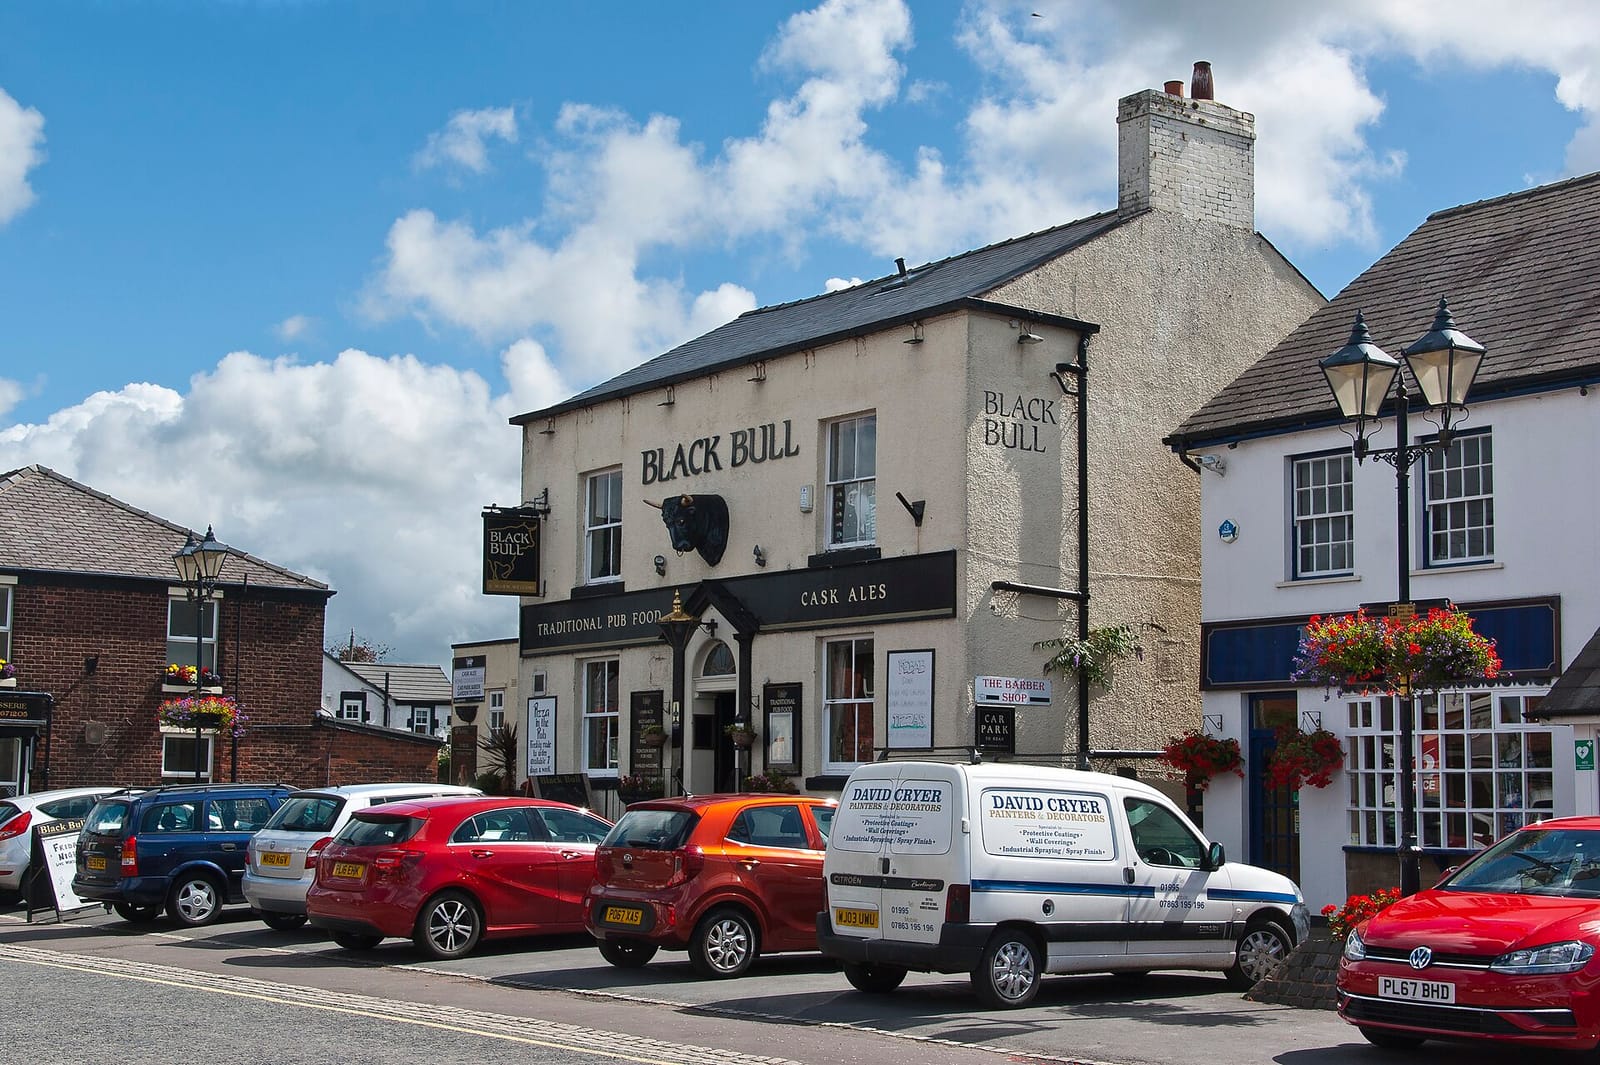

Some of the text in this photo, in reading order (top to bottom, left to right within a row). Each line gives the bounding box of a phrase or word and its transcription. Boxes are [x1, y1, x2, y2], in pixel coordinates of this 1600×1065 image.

[983, 390, 1057, 425] BLACK
[984, 418, 1046, 452] BULL
[641, 419, 800, 485] BLACK BULL
[490, 531, 530, 544] BLACK
[490, 543, 524, 556] BULL
[801, 583, 887, 606] CASK ALES
[538, 609, 662, 636] TRADITIONAL PUB FOOD
[982, 678, 1046, 691] THE BARBER
[1002, 692, 1028, 703] SHOP
[533, 702, 550, 718] Pizza
[984, 714, 1005, 724] CAR
[981, 724, 1009, 735] PARK
[852, 788, 942, 803] DAVID CRYER
[849, 802, 883, 810] PAINTERS
[890, 803, 942, 812] DECORATORS
[992, 795, 1101, 814] DAVID CRYER
[990, 810, 1036, 820] PAINTERS
[1047, 812, 1106, 823] DECORATORS
[40, 818, 86, 834] Black Bul
[870, 836, 893, 845] Spraying
[897, 837, 913, 845] Spray
[1053, 831, 1080, 839] Coatings
[1034, 846, 1062, 855] Spraying
[1065, 848, 1084, 856] Spray
[911, 880, 938, 890] Berlingo
[1160, 883, 1180, 892] 01995
[891, 906, 909, 915] 01995
[1160, 899, 1205, 910] 07863 195 196
[890, 921, 935, 932] 07863 195 196
[1383, 979, 1450, 1000] PL67 BHD
